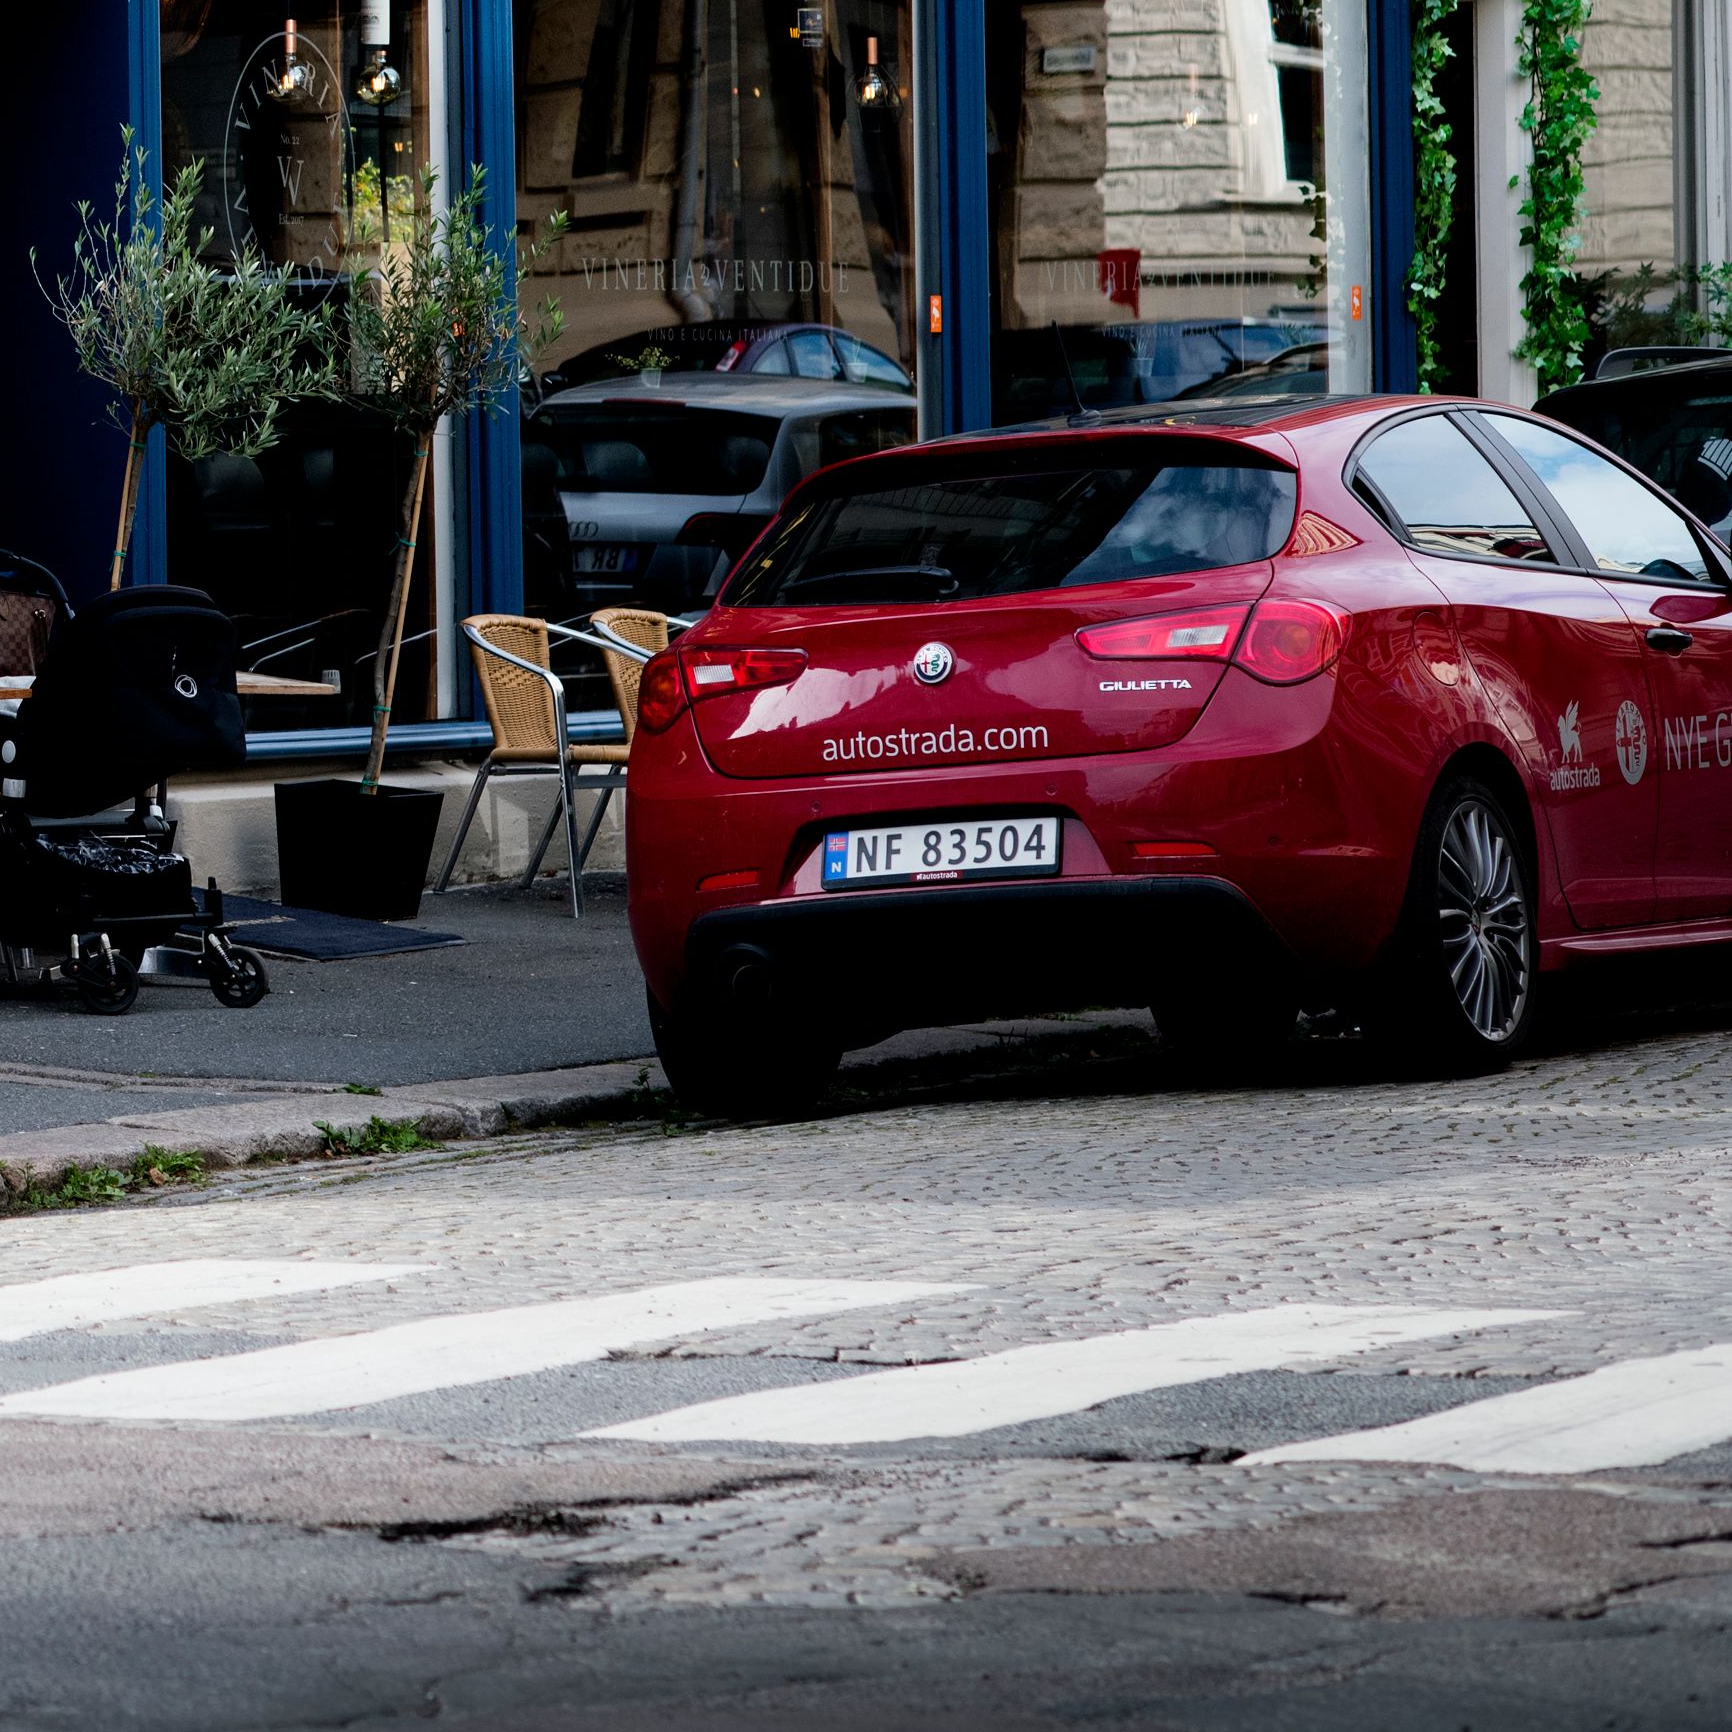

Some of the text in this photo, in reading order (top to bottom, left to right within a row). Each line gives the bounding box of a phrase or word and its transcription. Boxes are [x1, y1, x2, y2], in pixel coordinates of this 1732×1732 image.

[234, 58, 340, 140] VINRIA
[582, 258, 696, 291] VINERIA
[714, 260, 849, 293] VENTIDUE
[648, 328, 675, 340] VINO
[692, 328, 733, 341] CUCINA
[1099, 679, 1193, 692] GIULIETTA
[822, 723, 1049, 761] autostrada.com
[1664, 715, 1710, 771] NYE
[1550, 762, 1601, 791] autostrada
[831, 823, 1046, 873] N NF 83504
[921, 871, 958, 880] autostrada
